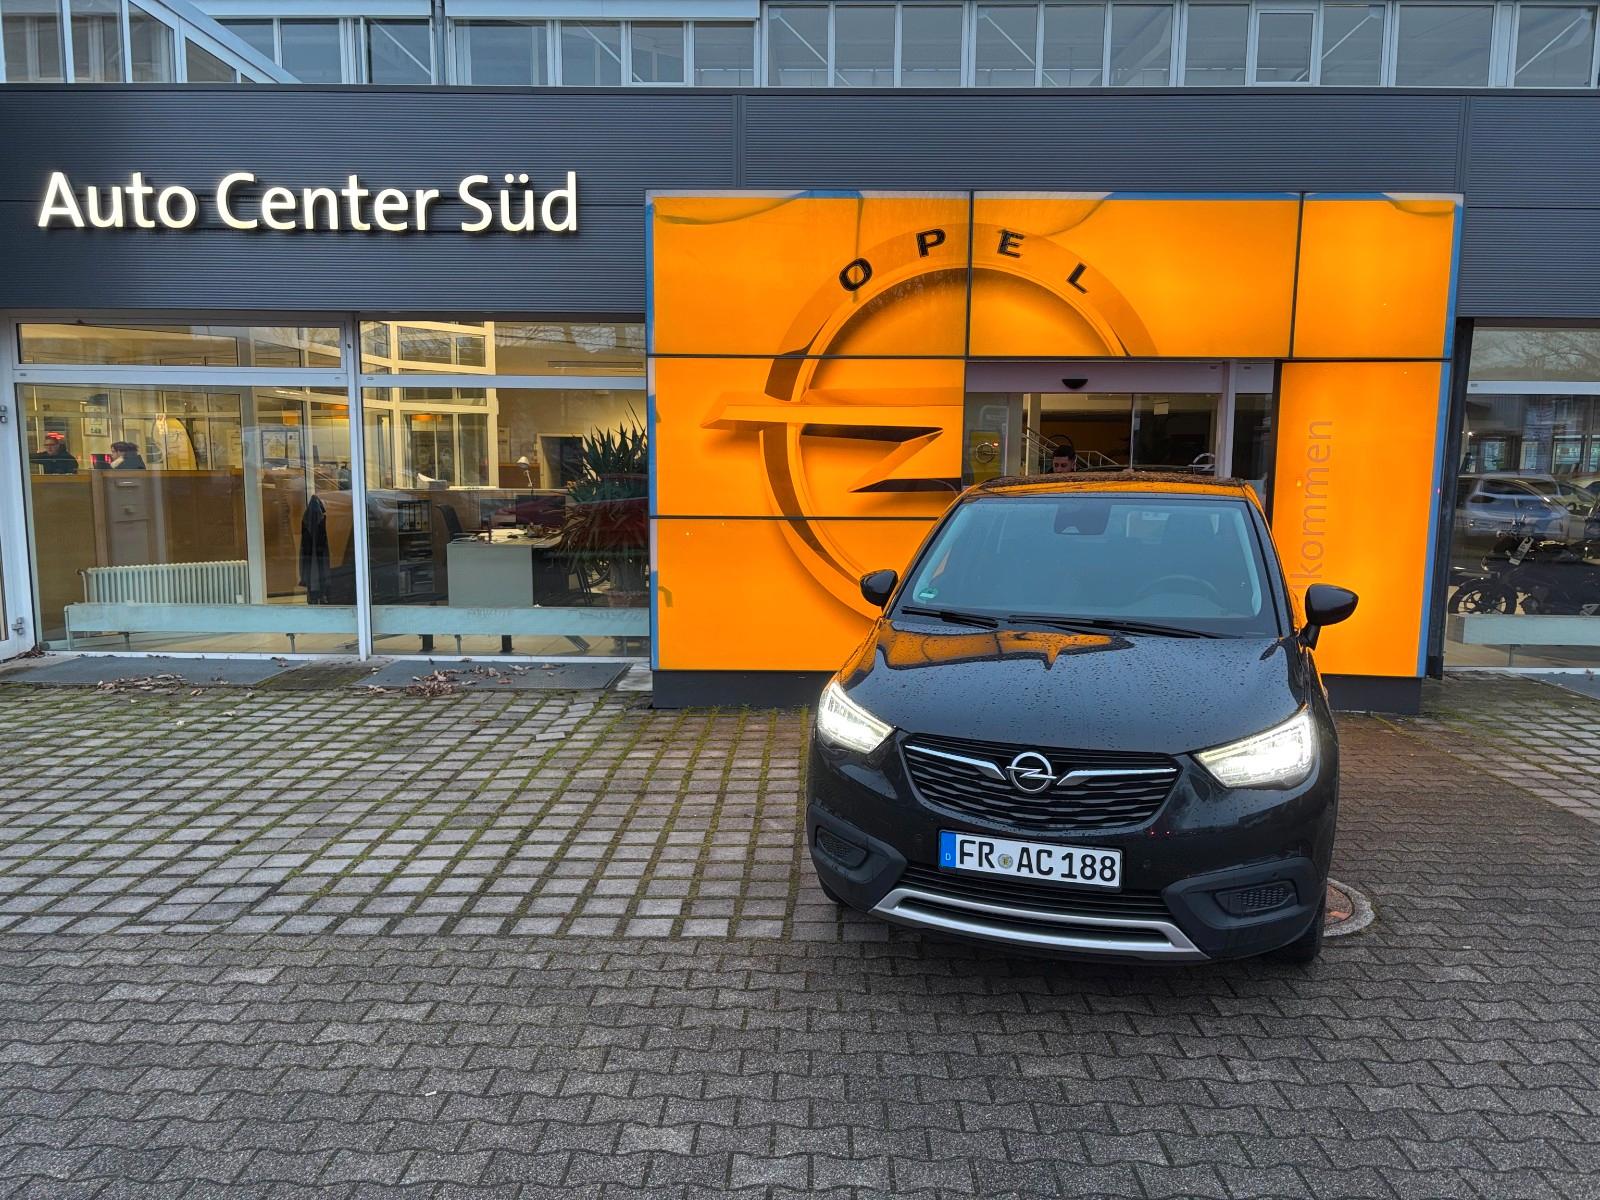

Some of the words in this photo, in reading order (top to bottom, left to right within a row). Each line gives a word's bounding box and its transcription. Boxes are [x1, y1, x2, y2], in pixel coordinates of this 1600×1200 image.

[37, 171, 198, 229] Auto
[216, 172, 440, 231] Center
[457, 171, 577, 232] Süd
[838, 228, 1088, 295] OPEL
[945, 852, 951, 861] D
[959, 839, 995, 868] FR
[1016, 846, 1054, 876] AC
[1060, 852, 1117, 882] 188
